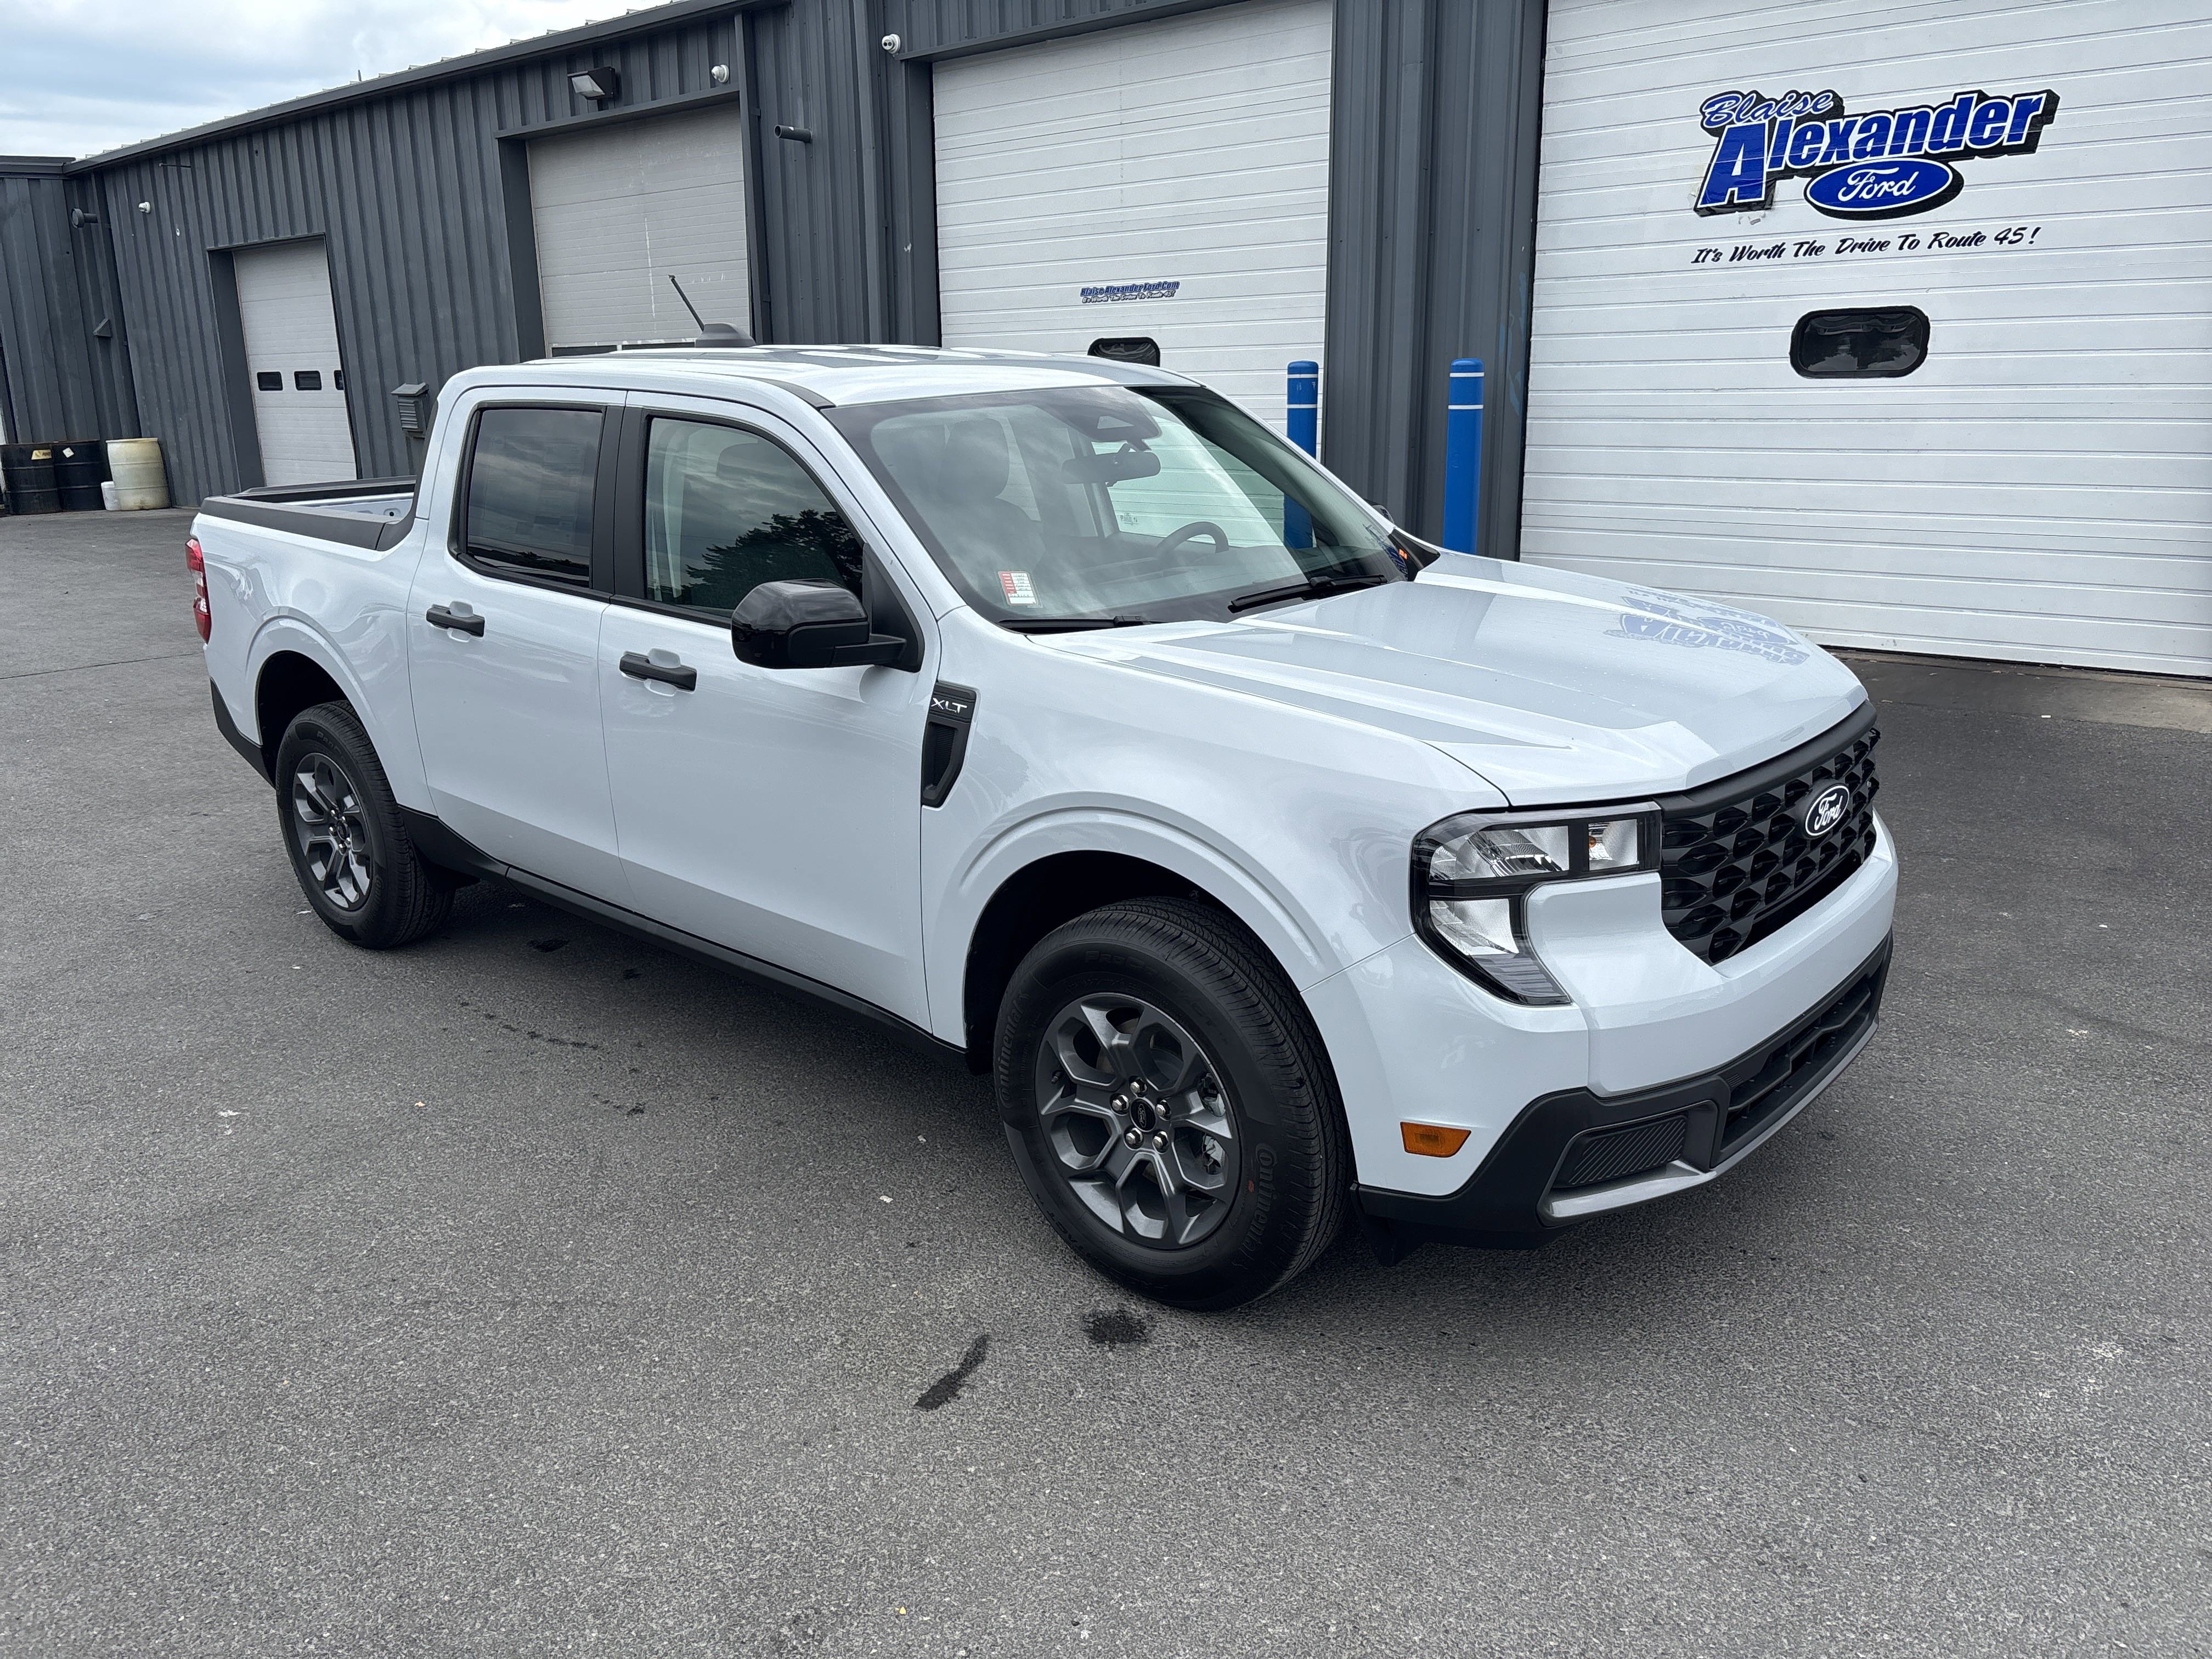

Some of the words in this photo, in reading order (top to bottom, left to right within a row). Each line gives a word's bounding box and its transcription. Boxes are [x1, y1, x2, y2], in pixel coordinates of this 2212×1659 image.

[1701, 91, 1835, 129] Blaise
[1696, 91, 2049, 209] Alexander
[1836, 166, 1917, 202] Ford
[1691, 248, 1723, 264] It's
[1728, 241, 1787, 262] Worth
[1792, 239, 1826, 258] The
[1834, 237, 1891, 255] Drive
[1897, 233, 1921, 251] To
[1927, 230, 1987, 250] Route
[1104, 284, 1143, 295] Alexander
[930, 697, 968, 714] XLT
[1814, 792, 1843, 831] Ford
